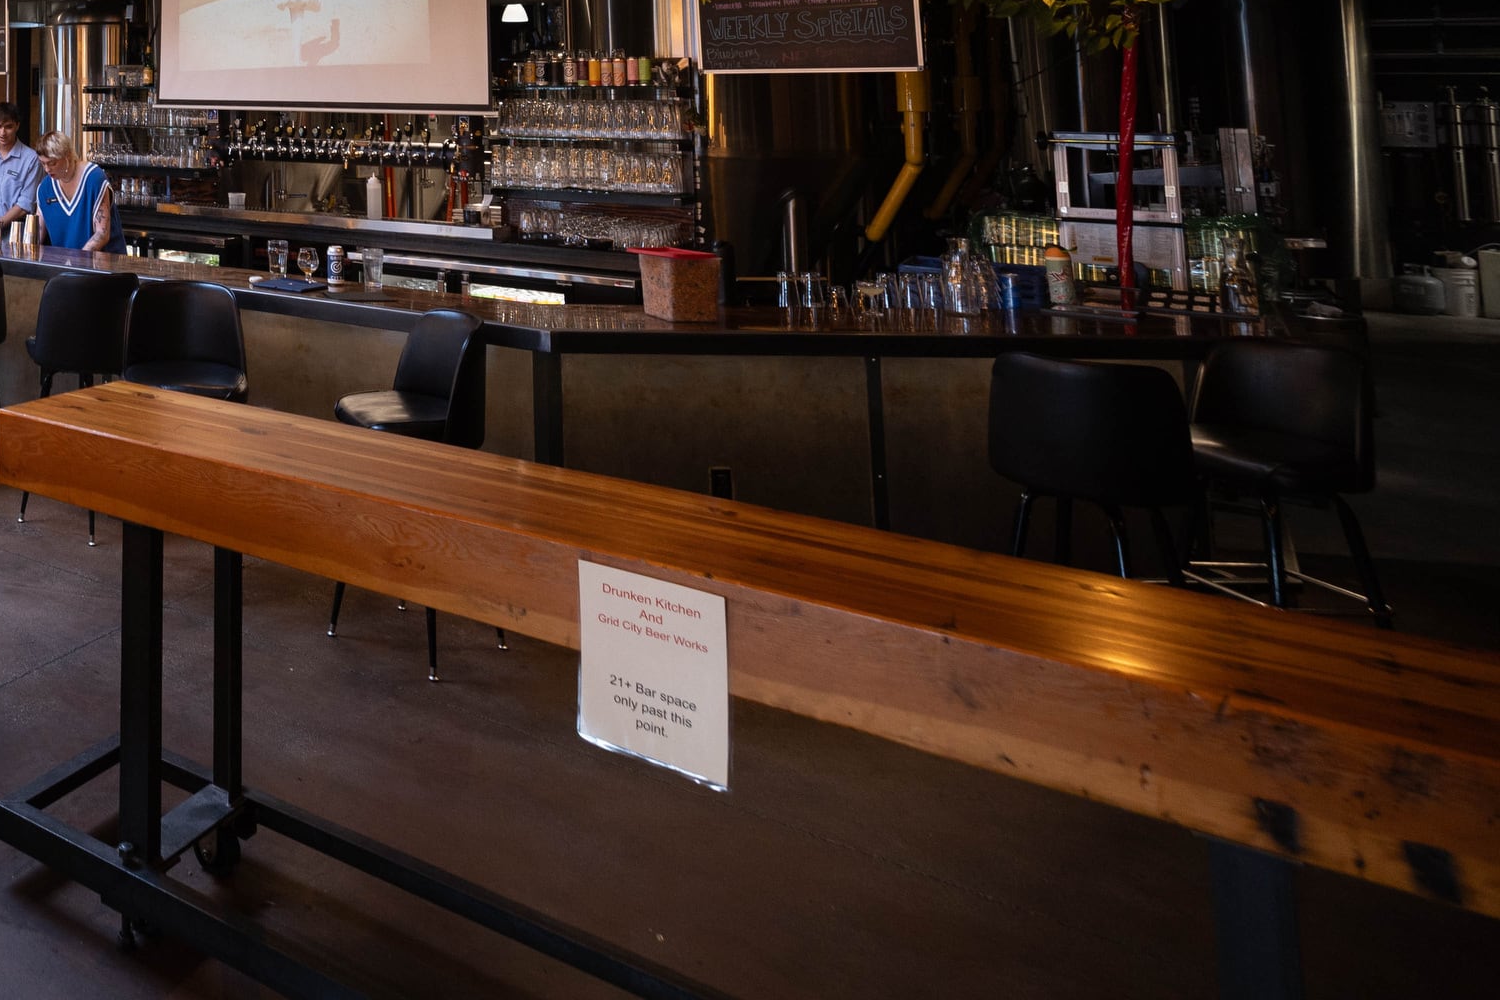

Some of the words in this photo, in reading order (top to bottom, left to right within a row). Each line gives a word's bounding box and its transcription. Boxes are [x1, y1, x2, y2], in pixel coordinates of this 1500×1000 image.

[706, 12, 789, 41] WEEKLY
[794, 6, 908, 39] SPECIALS
[602, 582, 652, 605] Drunken
[655, 597, 701, 619] Kitchen
[639, 609, 663, 625] And
[598, 613, 620, 627] Grid
[622, 620, 642, 634] City
[645, 627, 670, 642] Beer
[673, 634, 708, 653] Works
[610, 674, 631, 688] 21+
[635, 682, 657, 698] Bar
[660, 692, 697, 712] space
[613, 694, 638, 712] only
[641, 703, 668, 720] past
[670, 712, 692, 728] this
[635, 719, 668, 738] point.
